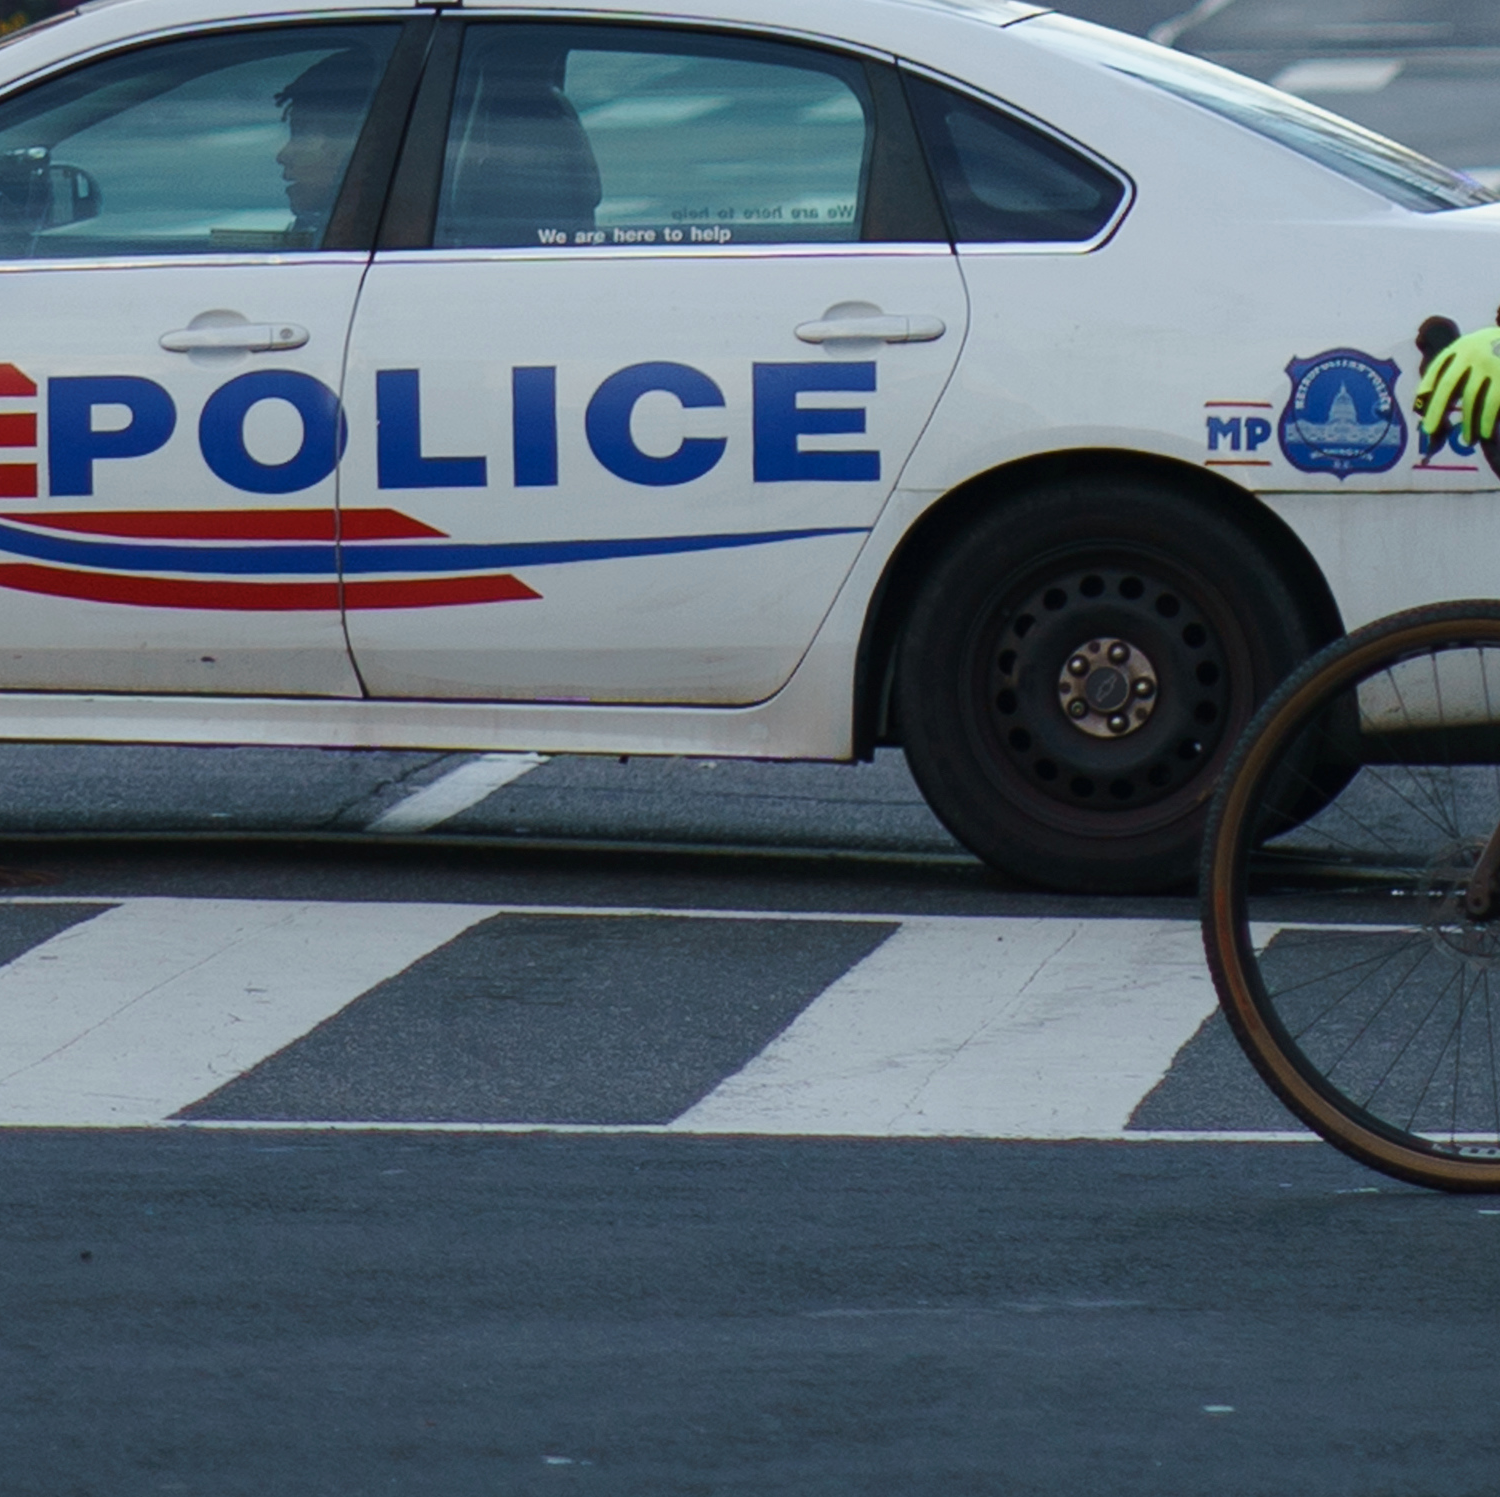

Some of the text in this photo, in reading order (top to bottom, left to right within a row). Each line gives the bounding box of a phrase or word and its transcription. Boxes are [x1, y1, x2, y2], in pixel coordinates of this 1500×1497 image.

[538, 225, 732, 245] We are here to help
[46, 360, 882, 497] POLICE
[1206, 416, 1272, 451] MP
